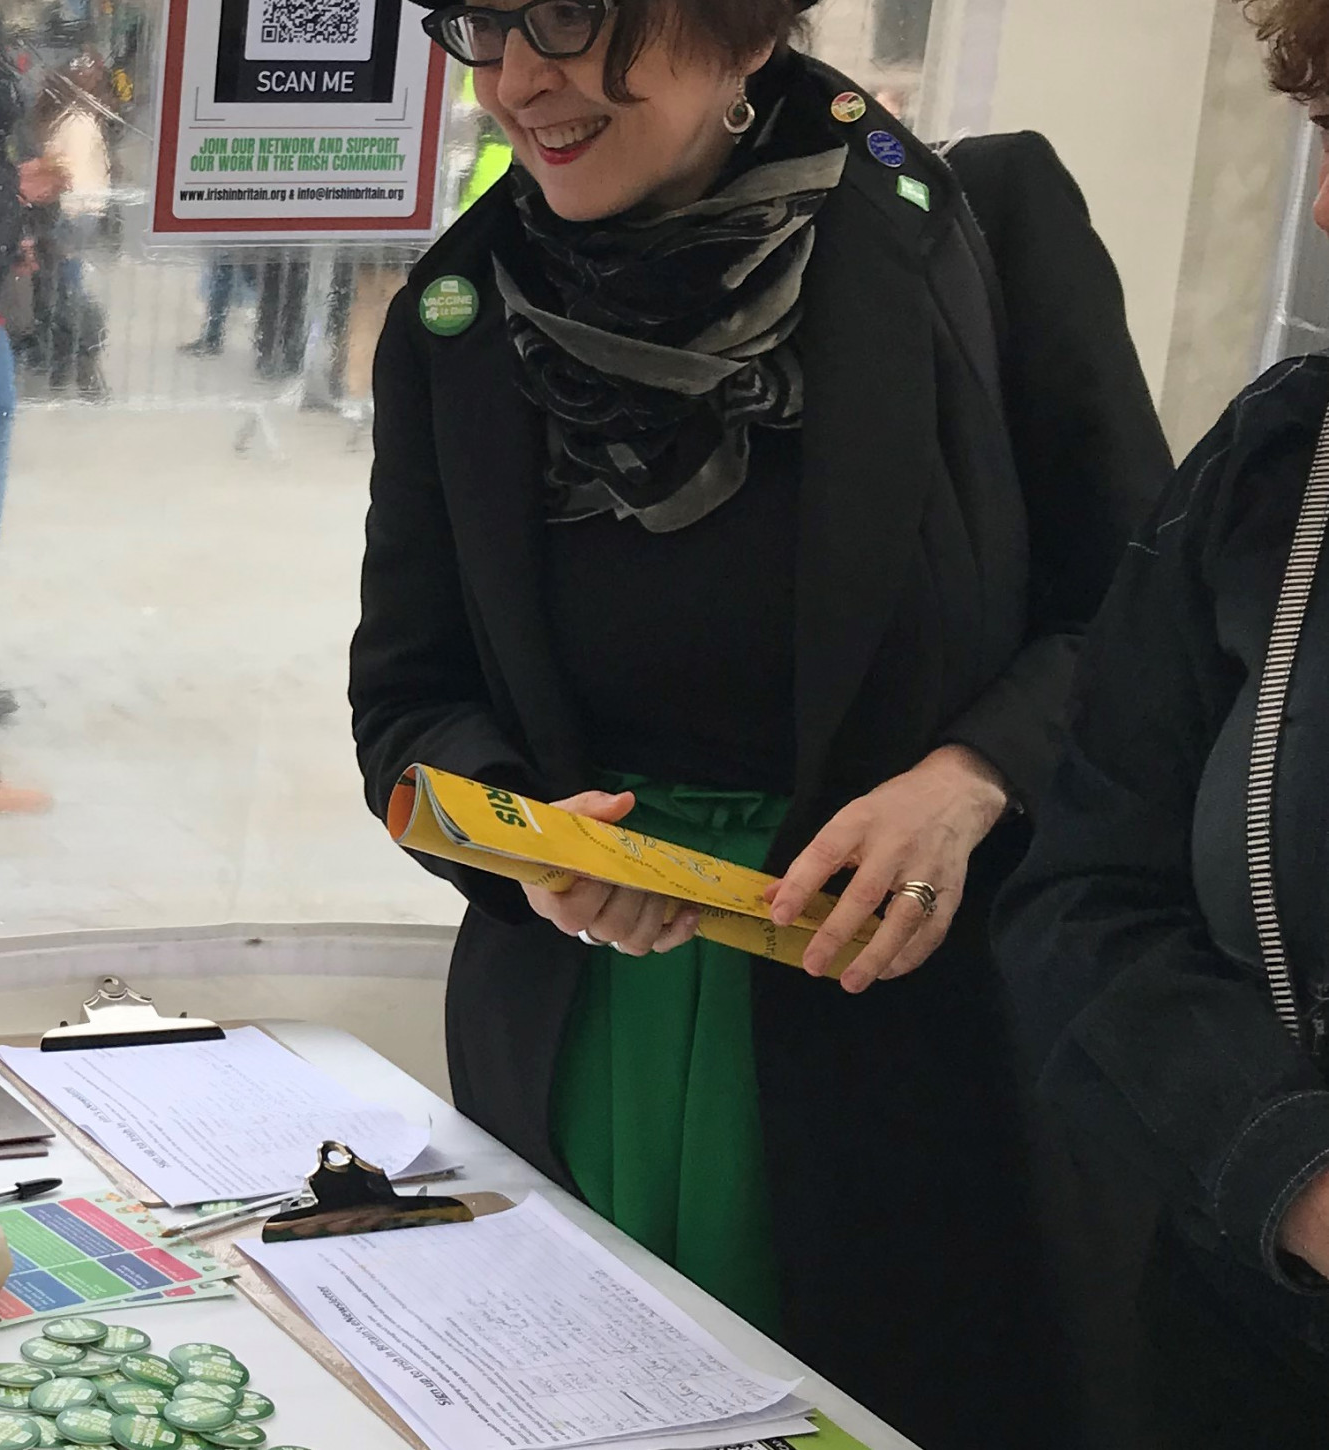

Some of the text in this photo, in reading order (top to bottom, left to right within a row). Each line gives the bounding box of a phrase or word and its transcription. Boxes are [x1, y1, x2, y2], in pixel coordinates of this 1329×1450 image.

[256, 71, 355, 92] SCAN ME
[200, 137, 399, 154] JOIN OUR NETWORK AND SUPPORT
[190, 154, 406, 171] OUR WORK IN THE IRISH COMMUNITY
[180, 187, 404, 201] www.irishinbritain.org & info@irishinbritain.org
[385, 1350, 397, 1359] in
[189, 1360, 244, 1378] VACCINE
[392, 1357, 412, 1373] Irish
[410, 1369, 423, 1380] to
[420, 1377, 434, 1389] up
[431, 1389, 453, 1406] Sign
[67, 1410, 112, 1428] VACCIN
